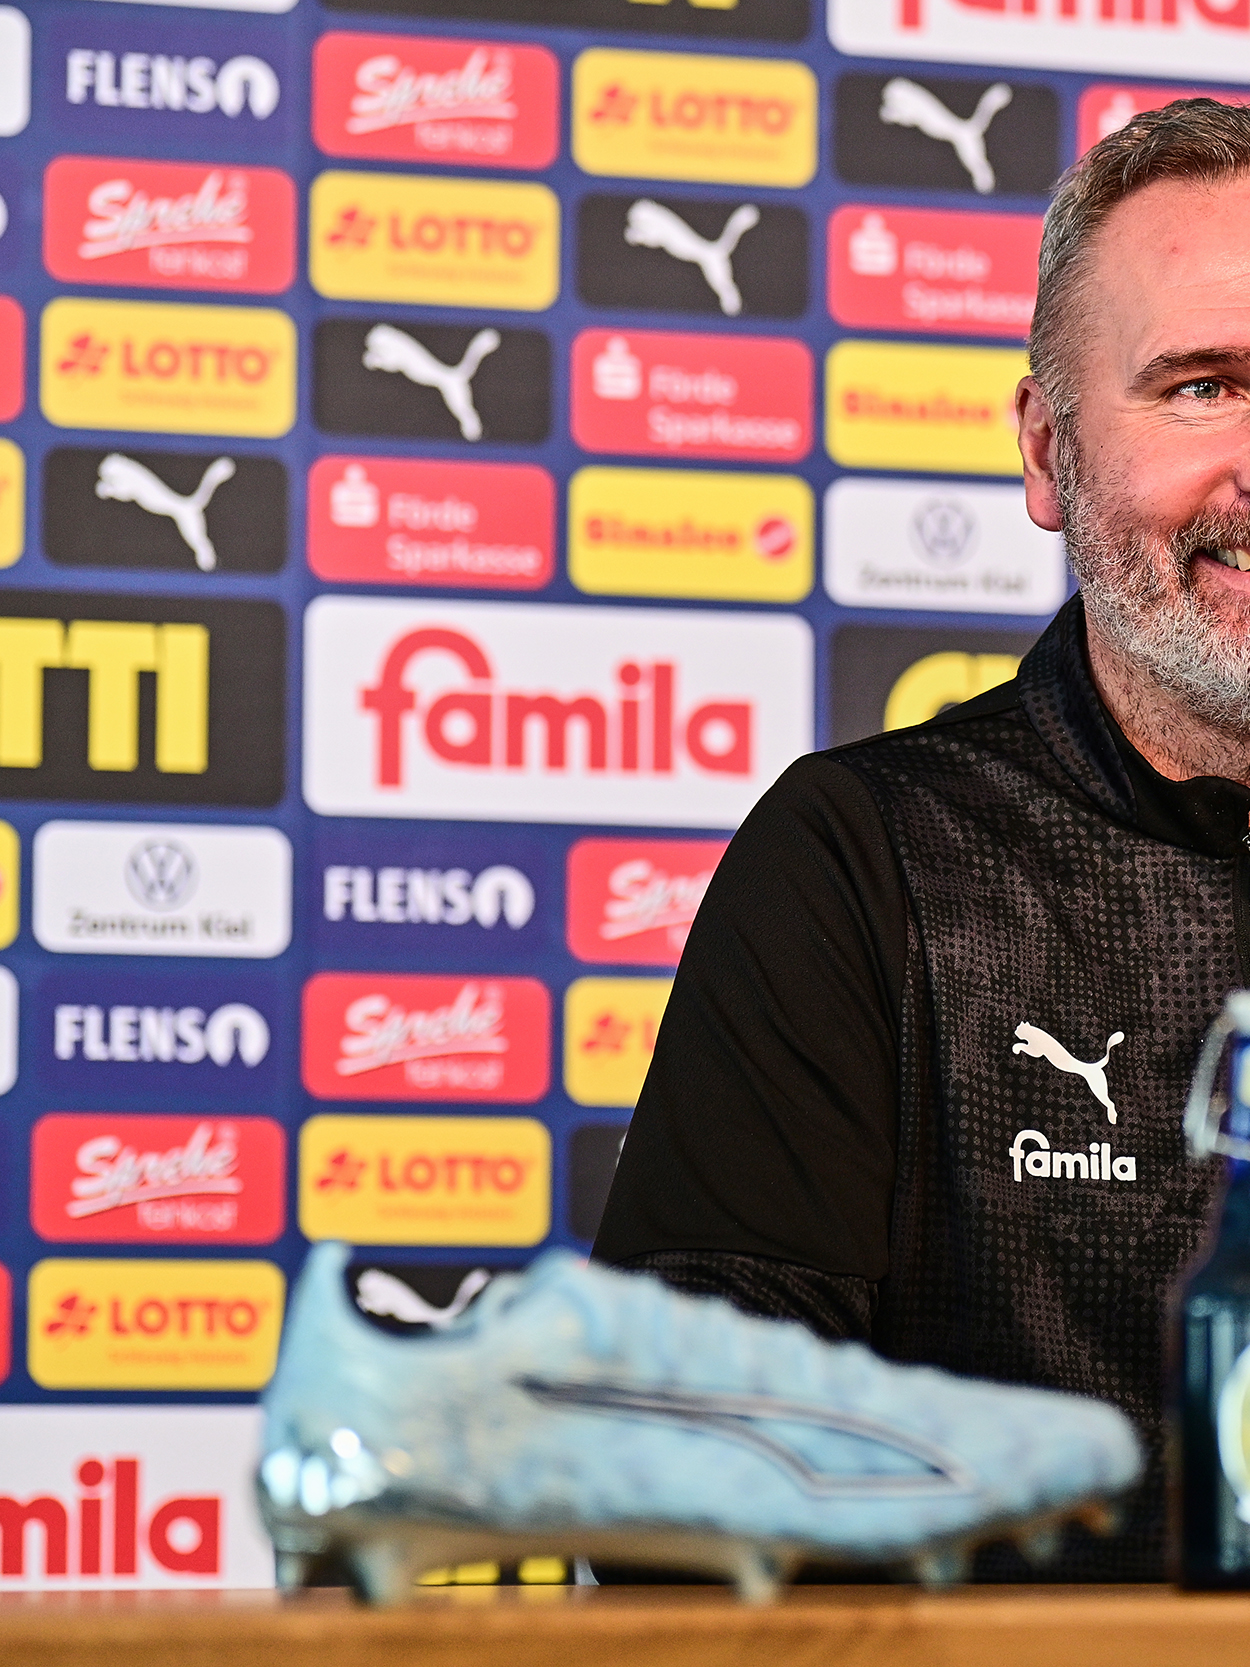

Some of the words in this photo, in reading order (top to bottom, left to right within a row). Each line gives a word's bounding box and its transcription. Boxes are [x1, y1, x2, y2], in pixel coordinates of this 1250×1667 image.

[649, 88, 796, 136] LOTTO
[388, 213, 537, 259] LOTTO
[121, 339, 272, 385] LOTTO
[388, 493, 477, 531] Förde
[387, 534, 541, 576] Sparkasse
[360, 626, 754, 788] famila
[68, 908, 190, 937] Zentrum
[199, 914, 252, 940] Kiel
[379, 1152, 528, 1195] LOTTO
[1008, 1129, 1137, 1183] famila
[110, 1297, 260, 1338] LOTTO
